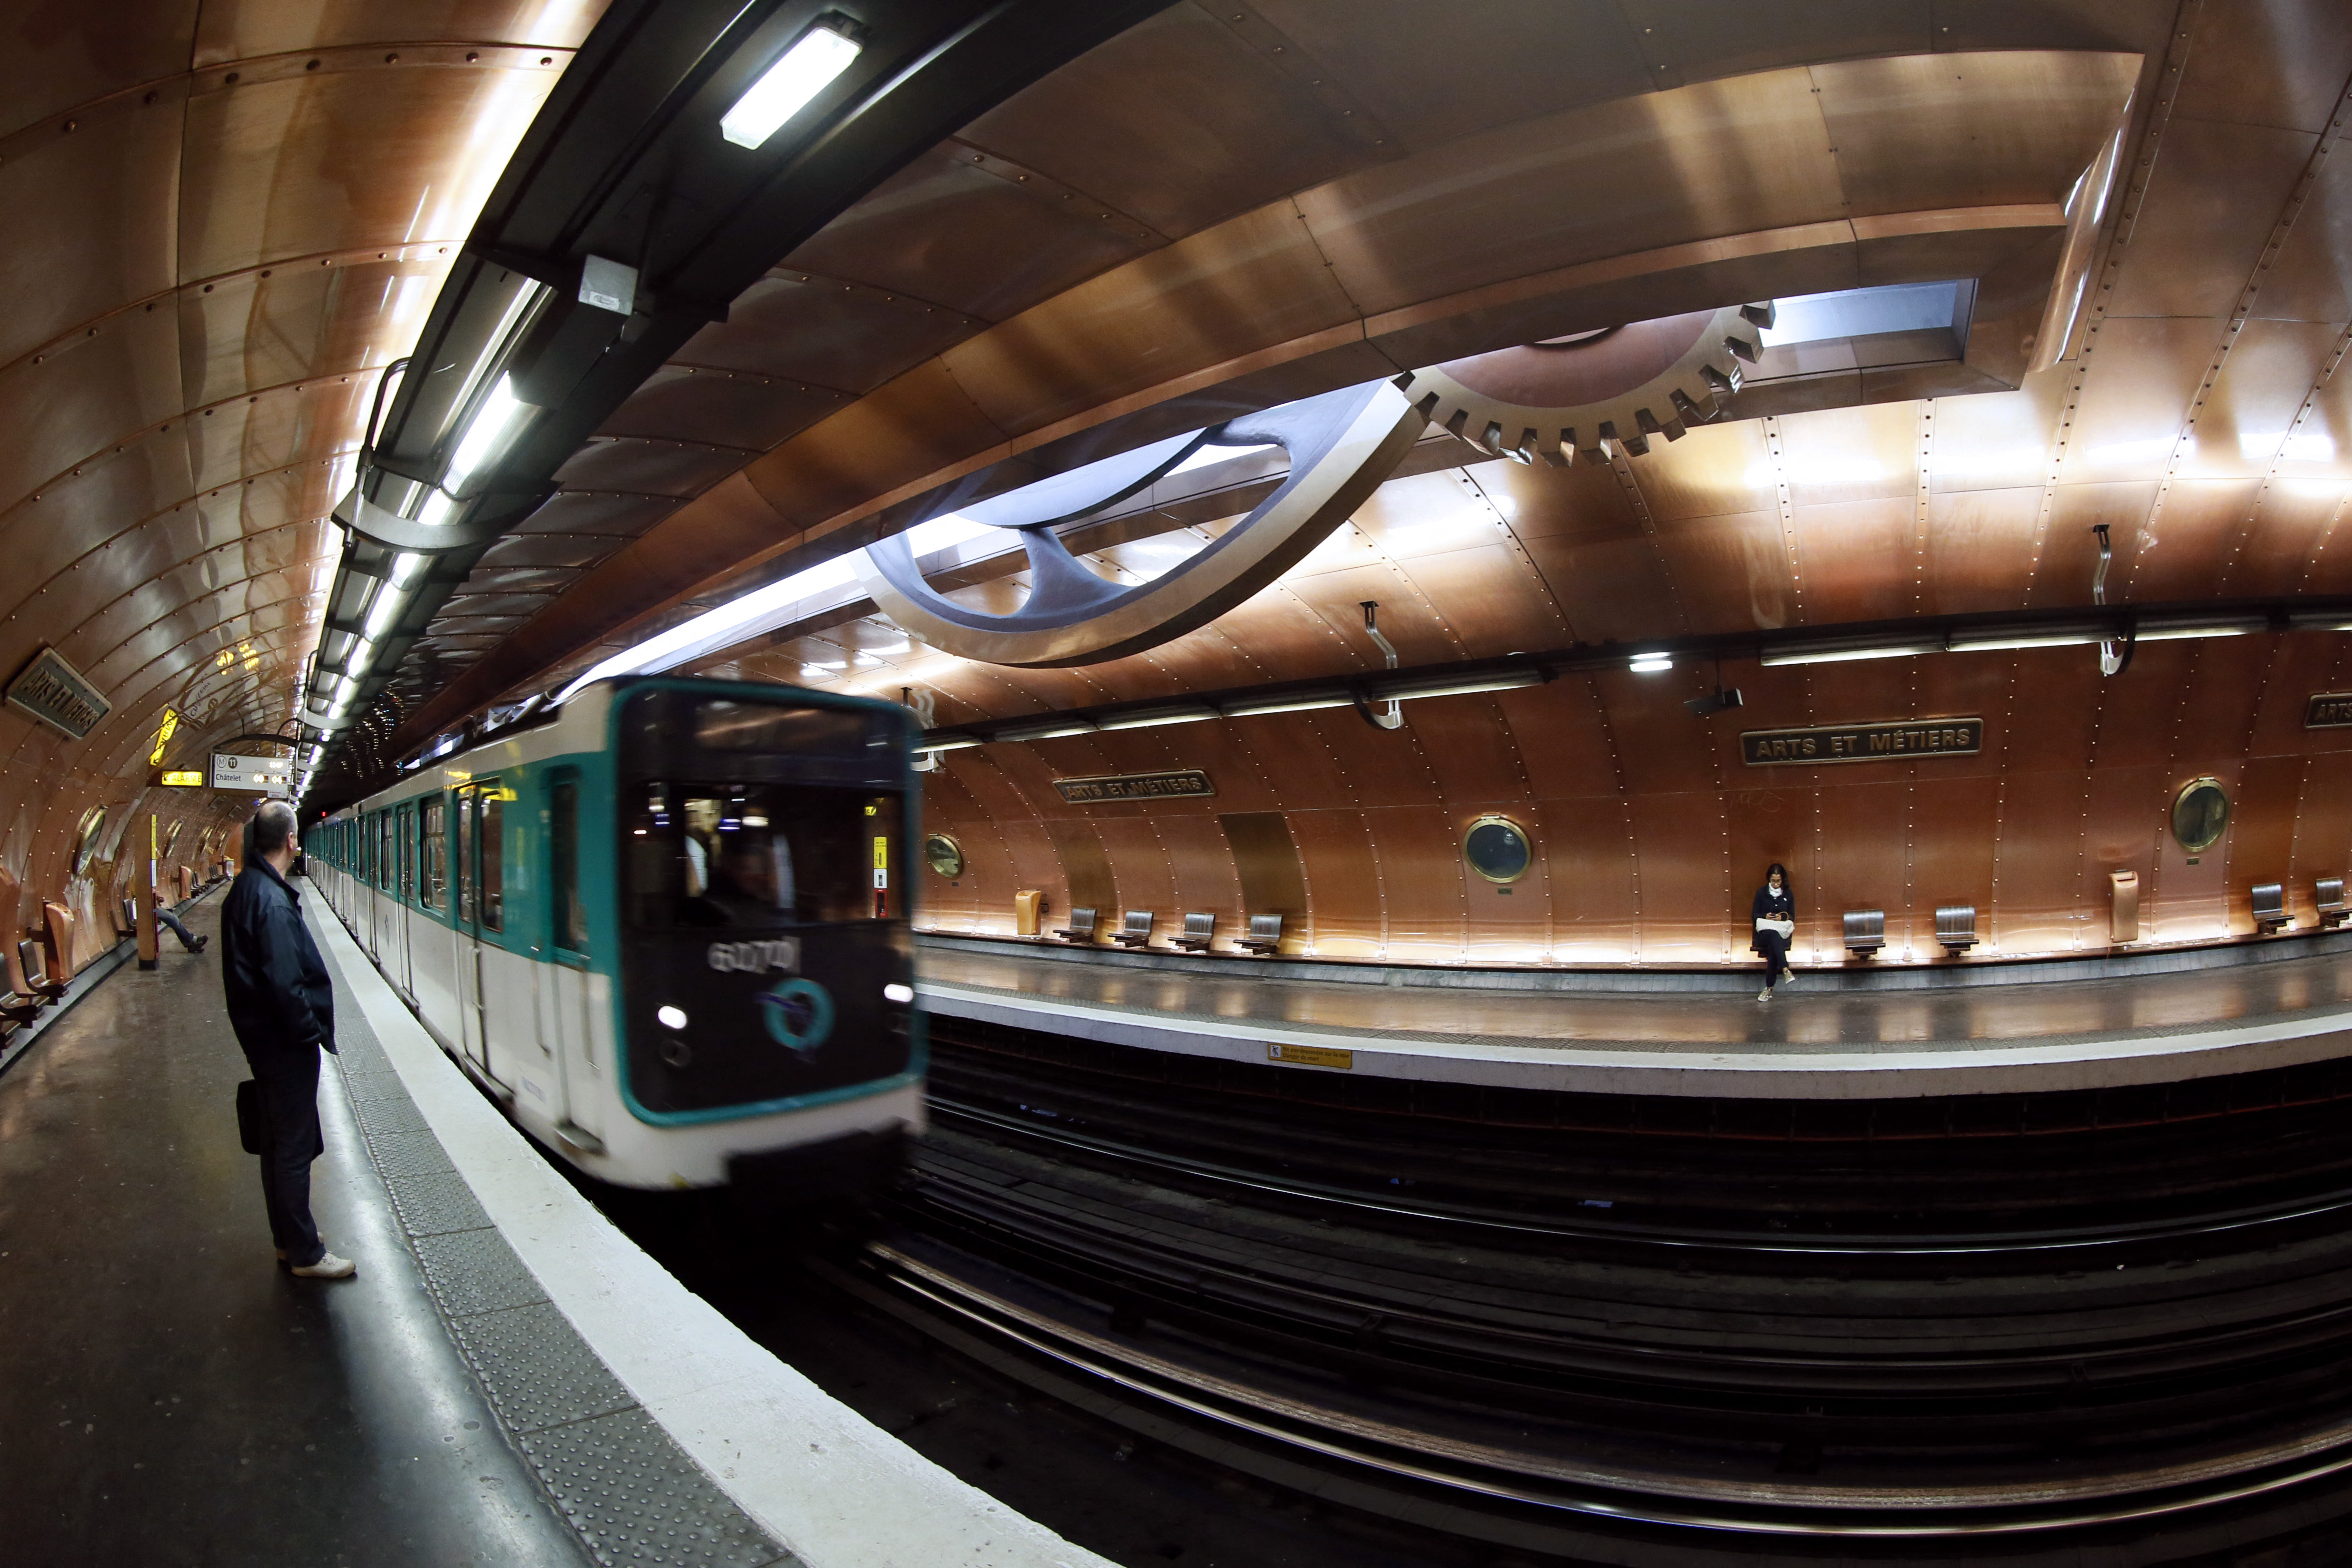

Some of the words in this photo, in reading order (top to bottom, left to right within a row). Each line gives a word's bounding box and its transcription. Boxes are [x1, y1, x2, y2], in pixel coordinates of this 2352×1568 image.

[1756, 738, 1815, 757] ARTS
[1831, 735, 1857, 754] ET
[1870, 729, 1970, 751] MÉTIERS
[216, 774, 241, 782] Châtelet
[1066, 784, 1103, 798] ARTS
[1106, 783, 1126, 795] ET
[1129, 777, 1203, 794] MÉTIERS
